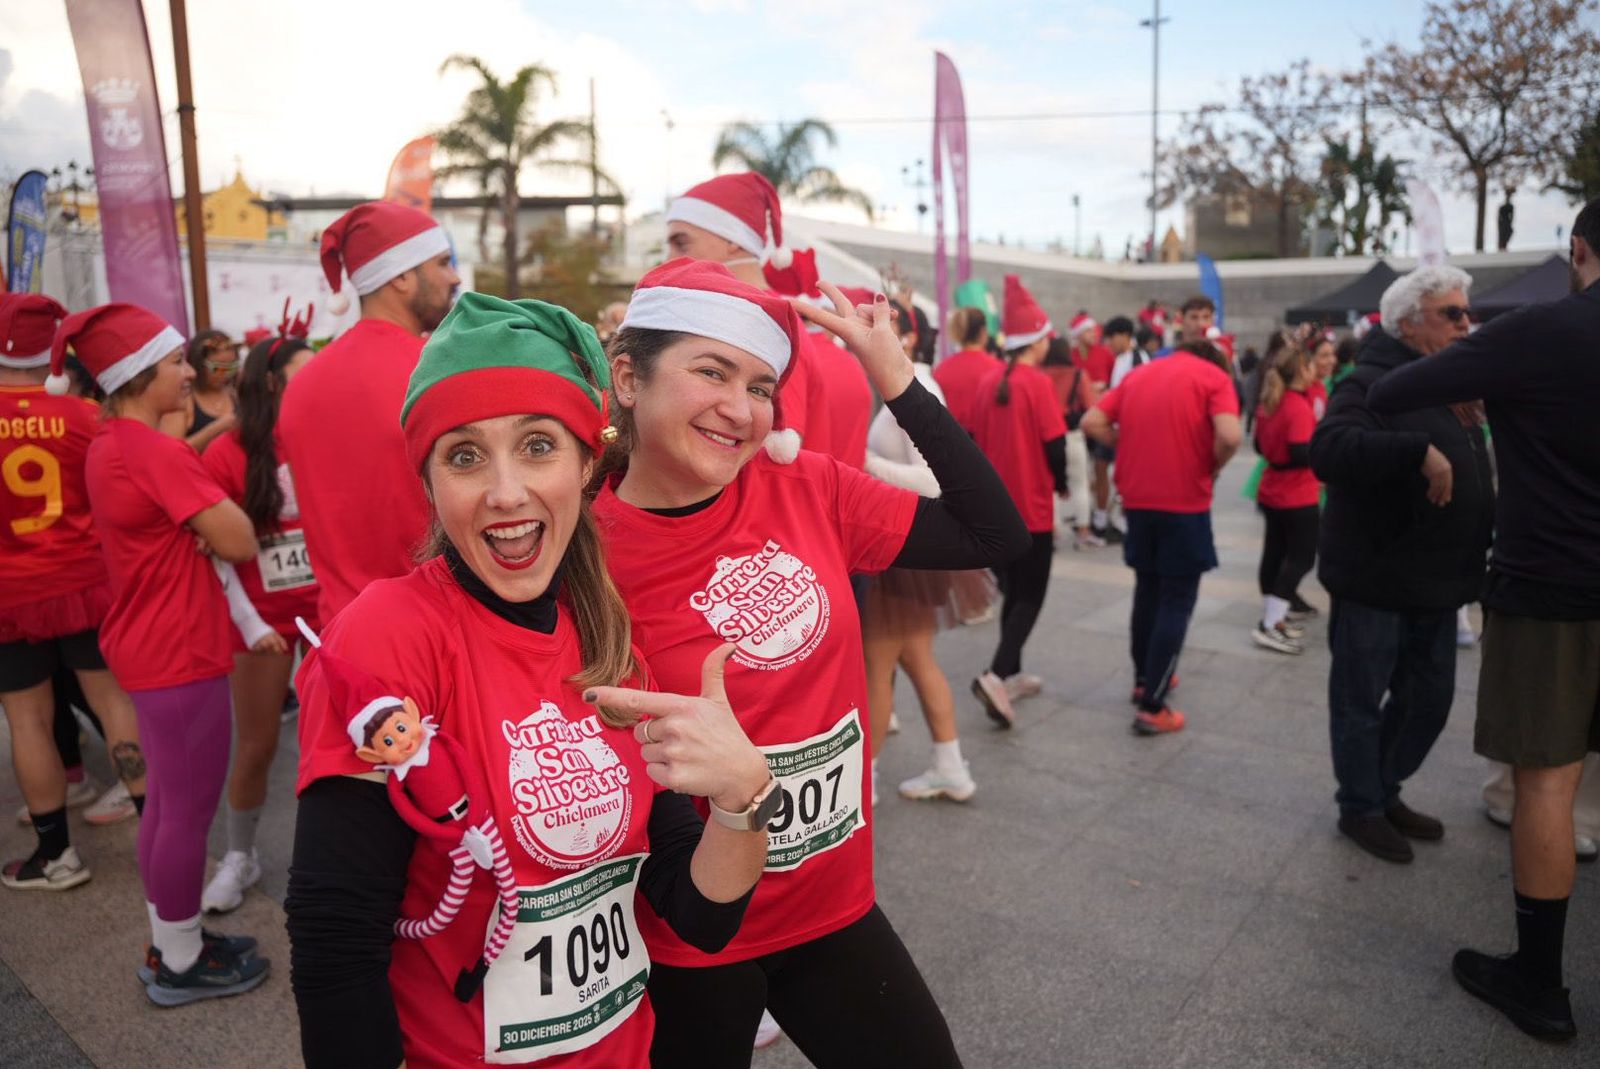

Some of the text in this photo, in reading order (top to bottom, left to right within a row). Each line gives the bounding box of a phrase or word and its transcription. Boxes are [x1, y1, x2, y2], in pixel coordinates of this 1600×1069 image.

[2, 443, 63, 535] 9
[689, 539, 781, 612] Carrera
[728, 573, 784, 610] San
[718, 565, 817, 643] Silvestre
[751, 595, 815, 646] Chiclanera
[766, 657, 797, 672] Deportes
[799, 649, 813, 661] Club
[502, 714, 604, 750] Carrera
[535, 746, 592, 778] San
[778, 755, 795, 767] SAN
[794, 744, 829, 763] SILVESTRE
[513, 764, 631, 815] Silvestre
[767, 763, 844, 834] 907
[543, 797, 620, 830] Chiclanera
[767, 831, 802, 846] STELA
[804, 805, 849, 836] GALLARDO
[536, 855, 546, 864] de
[545, 857, 580, 870] Deportes
[517, 891, 560, 909] CARRERA
[559, 887, 572, 900] SAN
[572, 874, 599, 897] SILVESTRE
[598, 864, 630, 882] CHICLANERA
[524, 902, 630, 996] 1090
[579, 976, 610, 1003] SARITA
[503, 1013, 593, 1044] 30 DICIEMBRE 2025
